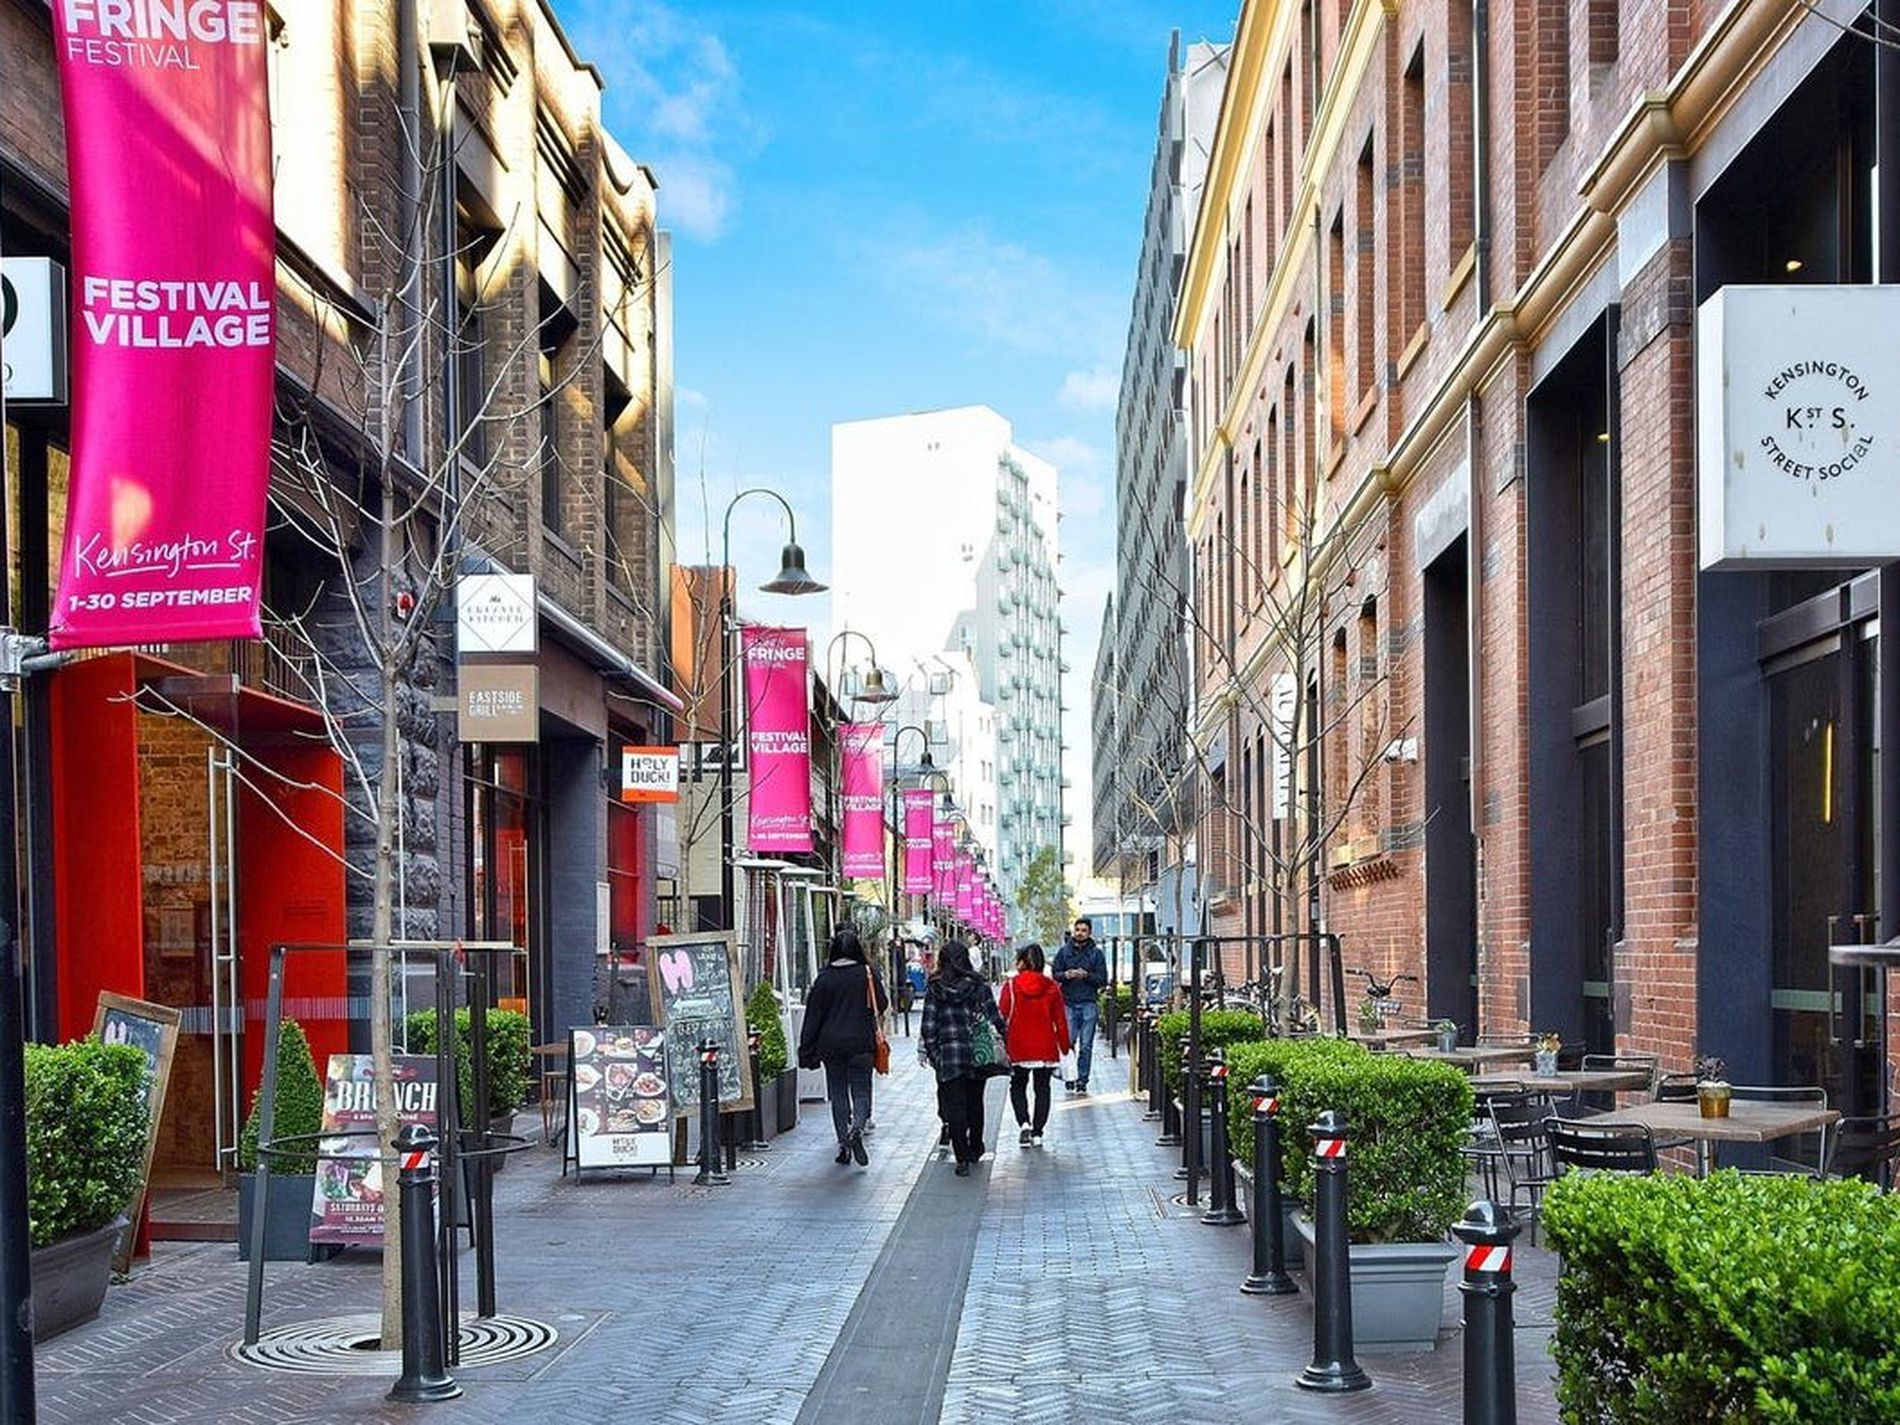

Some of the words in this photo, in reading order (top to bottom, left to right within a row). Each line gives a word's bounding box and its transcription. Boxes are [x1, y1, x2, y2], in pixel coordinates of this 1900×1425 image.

[66, 0, 260, 43] FRINGE
[68, 38, 200, 69] FESTIVAL
[84, 276, 270, 311] FESTIVAL
[82, 311, 270, 347] VILLAGE
[1764, 360, 1869, 400] KENSINGTON
[1761, 436, 1814, 480] STREET
[75, 532, 218, 578] Kensington
[69, 593, 116, 612] 1-30
[121, 585, 252, 609] SEPTEMBER
[747, 647, 806, 661] FRINGE
[469, 690, 523, 704] EASTSIDE
[751, 732, 808, 742] FESTIVAL
[751, 743, 808, 753] VILLAGE
[630, 771, 671, 783] DUCK!
[334, 1081, 438, 1112] BRNCH
